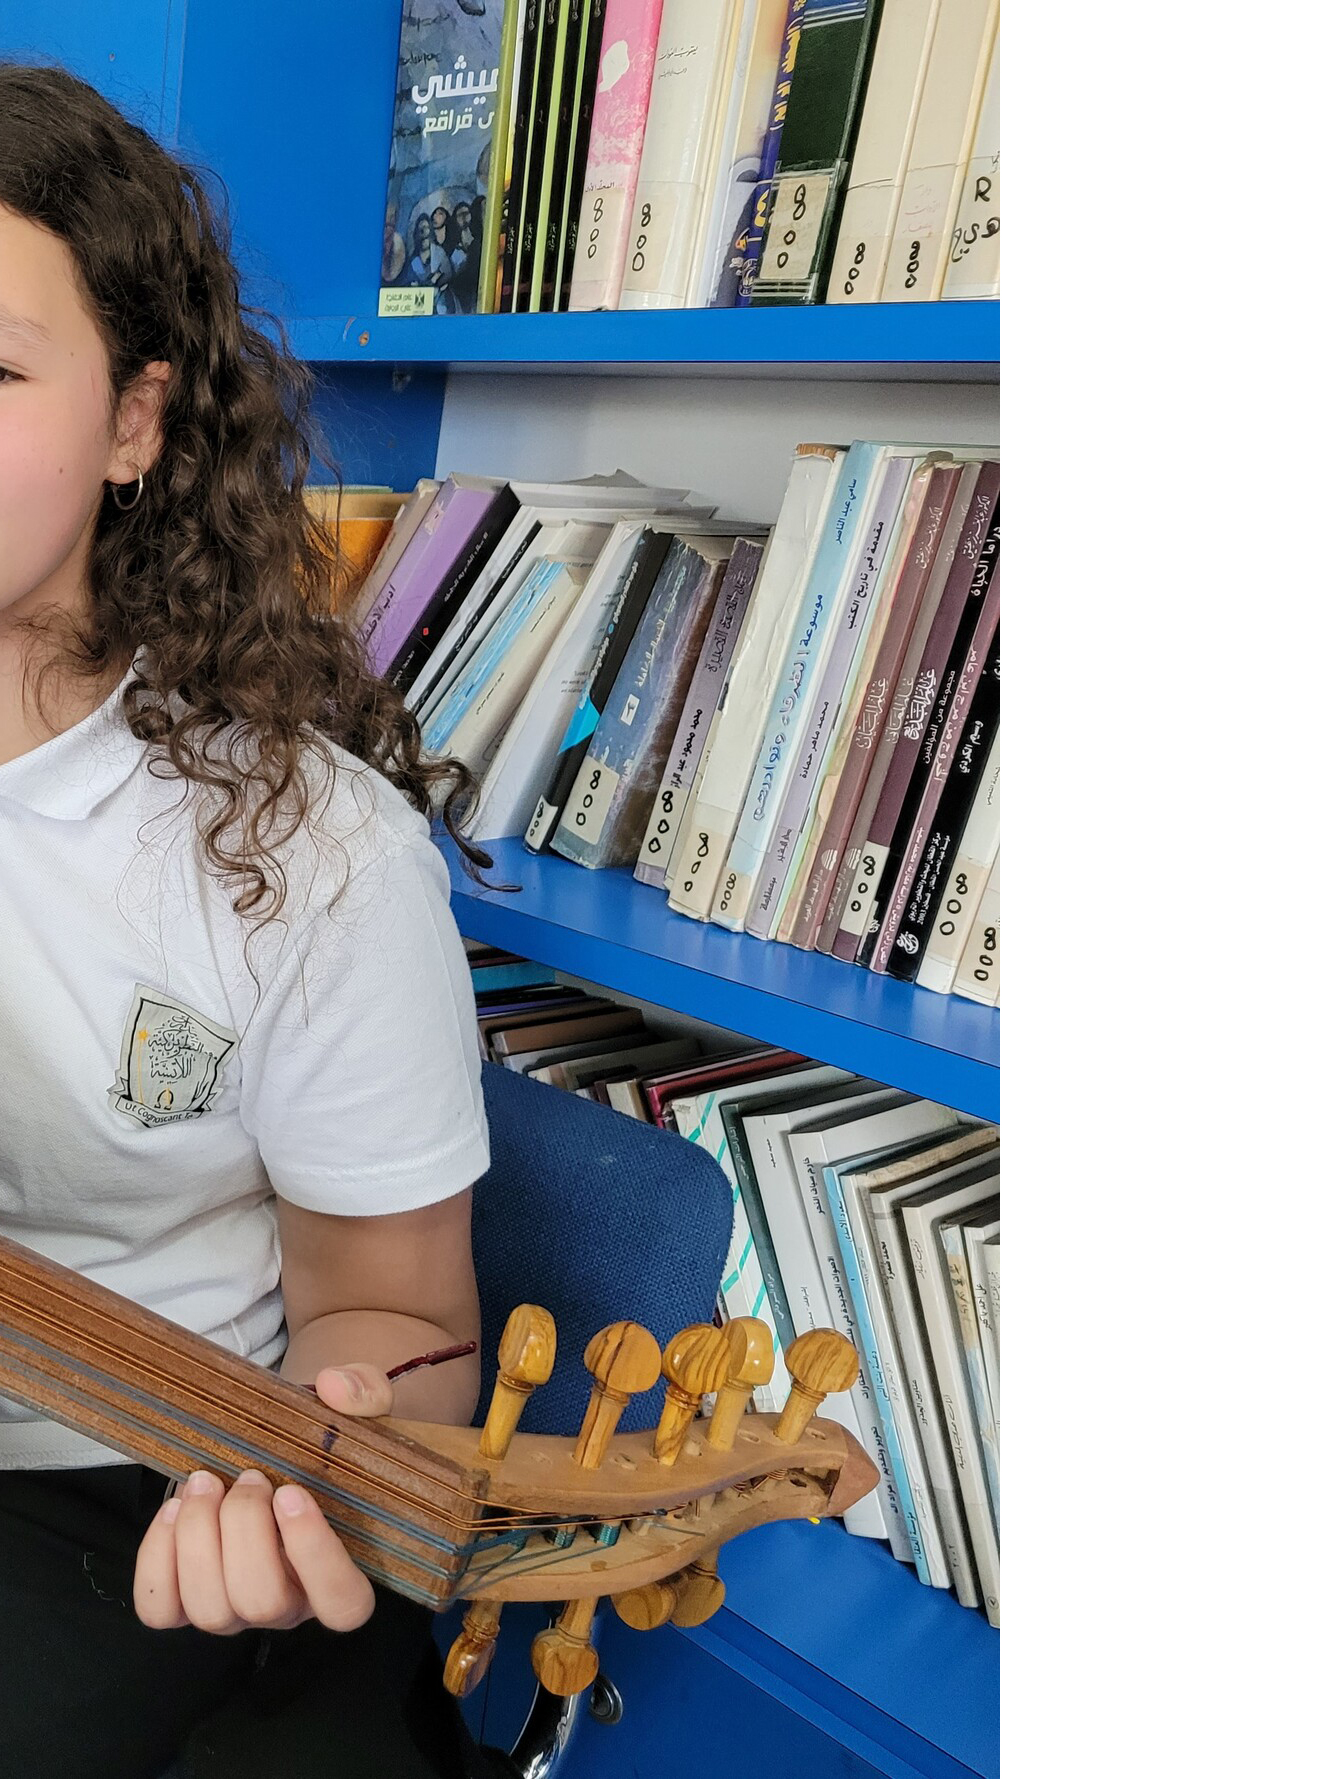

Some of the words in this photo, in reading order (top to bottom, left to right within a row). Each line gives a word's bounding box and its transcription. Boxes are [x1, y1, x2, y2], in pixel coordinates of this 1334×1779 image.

[423, 107, 473, 138] قراقع
[974, 176, 992, 202] R
[847, 478, 857, 500] سامي
[841, 500, 852, 516] عبد
[835, 517, 845, 544] الناصر
[867, 521, 884, 553] مقدمة
[864, 556, 877, 571] في
[854, 572, 868, 598] تاريخ
[970, 560, 989, 596] الحياة
[802, 594, 823, 646] موسوعة
[847, 599, 859, 629] الكتب
[967, 646, 978, 673] عامر
[938, 670, 955, 705] مجموعة
[959, 675, 971, 693] ابن
[690, 708, 702, 729] محمد
[817, 701, 829, 728] محمد
[937, 707, 944, 723] من
[951, 694, 964, 720] مرج
[682, 731, 695, 756] محمود
[811, 730, 820, 751] ماهر
[924, 723, 938, 763] المؤلفين
[946, 722, 957, 740] من
[969, 720, 983, 744] وسيم
[677, 759, 686, 771] عبد
[799, 752, 812, 778] حمادة
[934, 741, 951, 782] الخروج
[959, 743, 972, 773] الكردي
[931, 832, 941, 846] مركز
[939, 835, 950, 850] مؤسسة
[888, 909, 899, 932] درويش
[909, 843, 919, 862] محمد
[915, 879, 926, 902] والتطوير
[916, 909, 926, 924] 2003
[125, 1102, 137, 1111] Ut
[137, 1106, 183, 1123] Cognoscant
[881, 1241, 889, 1259] محمد
[836, 1285, 847, 1313] الجديدة
[843, 1314, 855, 1326] في
[873, 1426, 883, 1446] تحرير
[878, 1448, 890, 1475] وتقديم
[887, 1484, 896, 1501] مراد
[907, 1511, 916, 1535] مؤسسة
